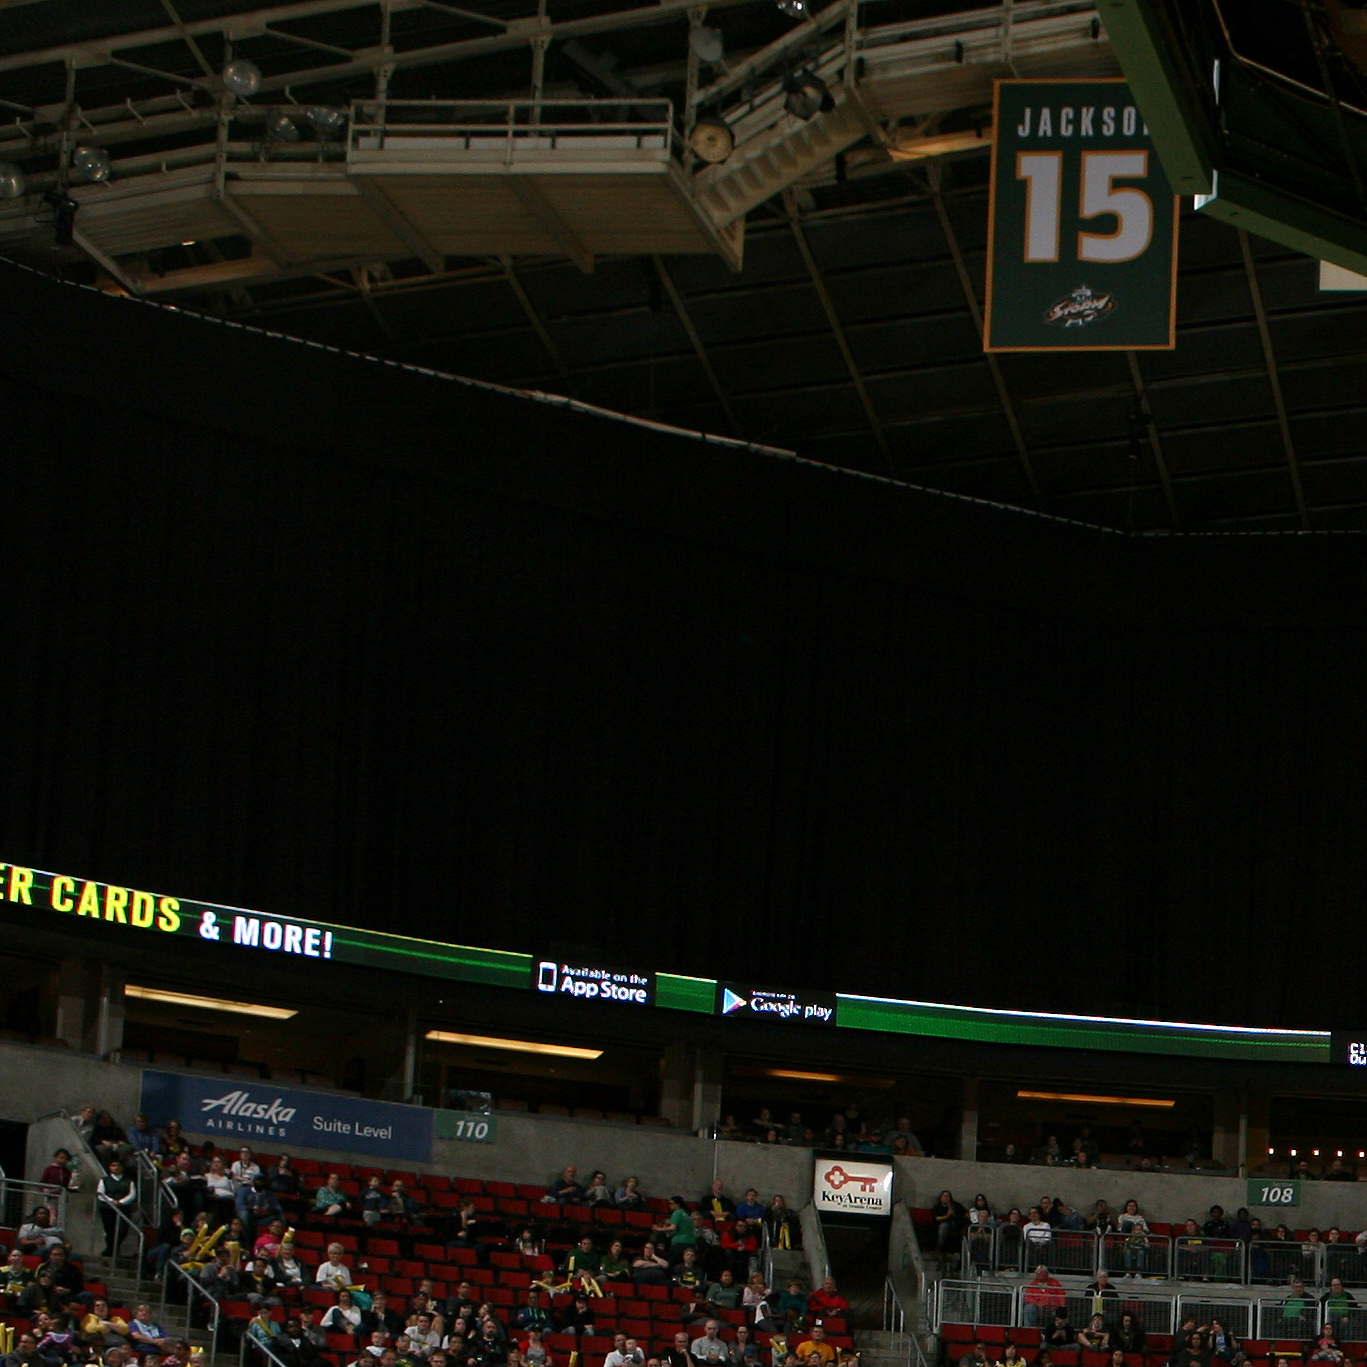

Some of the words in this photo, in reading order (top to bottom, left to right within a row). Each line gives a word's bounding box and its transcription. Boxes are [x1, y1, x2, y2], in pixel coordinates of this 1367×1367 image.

[1015, 150, 1154, 264] 15
[0, 862, 34, 906] R
[51, 875, 181, 933] CARDS
[198, 911, 221, 941] &
[232, 915, 334, 960] MORE!
[561, 964, 611, 981] Available
[613, 973, 627, 983] on
[630, 974, 648, 986] the
[560, 976, 598, 999] App
[600, 981, 647, 1004] Store
[750, 997, 800, 1019] Google
[804, 1003, 833, 1022] play
[201, 1090, 297, 1125] Alaska
[312, 1116, 351, 1135] Suite
[354, 1125, 392, 1140] Level
[206, 1118, 287, 1138] AIRLINES
[455, 1119, 489, 1140] 110
[821, 1190, 883, 1207] KeyArena
[1260, 1187, 1294, 1204] 108
